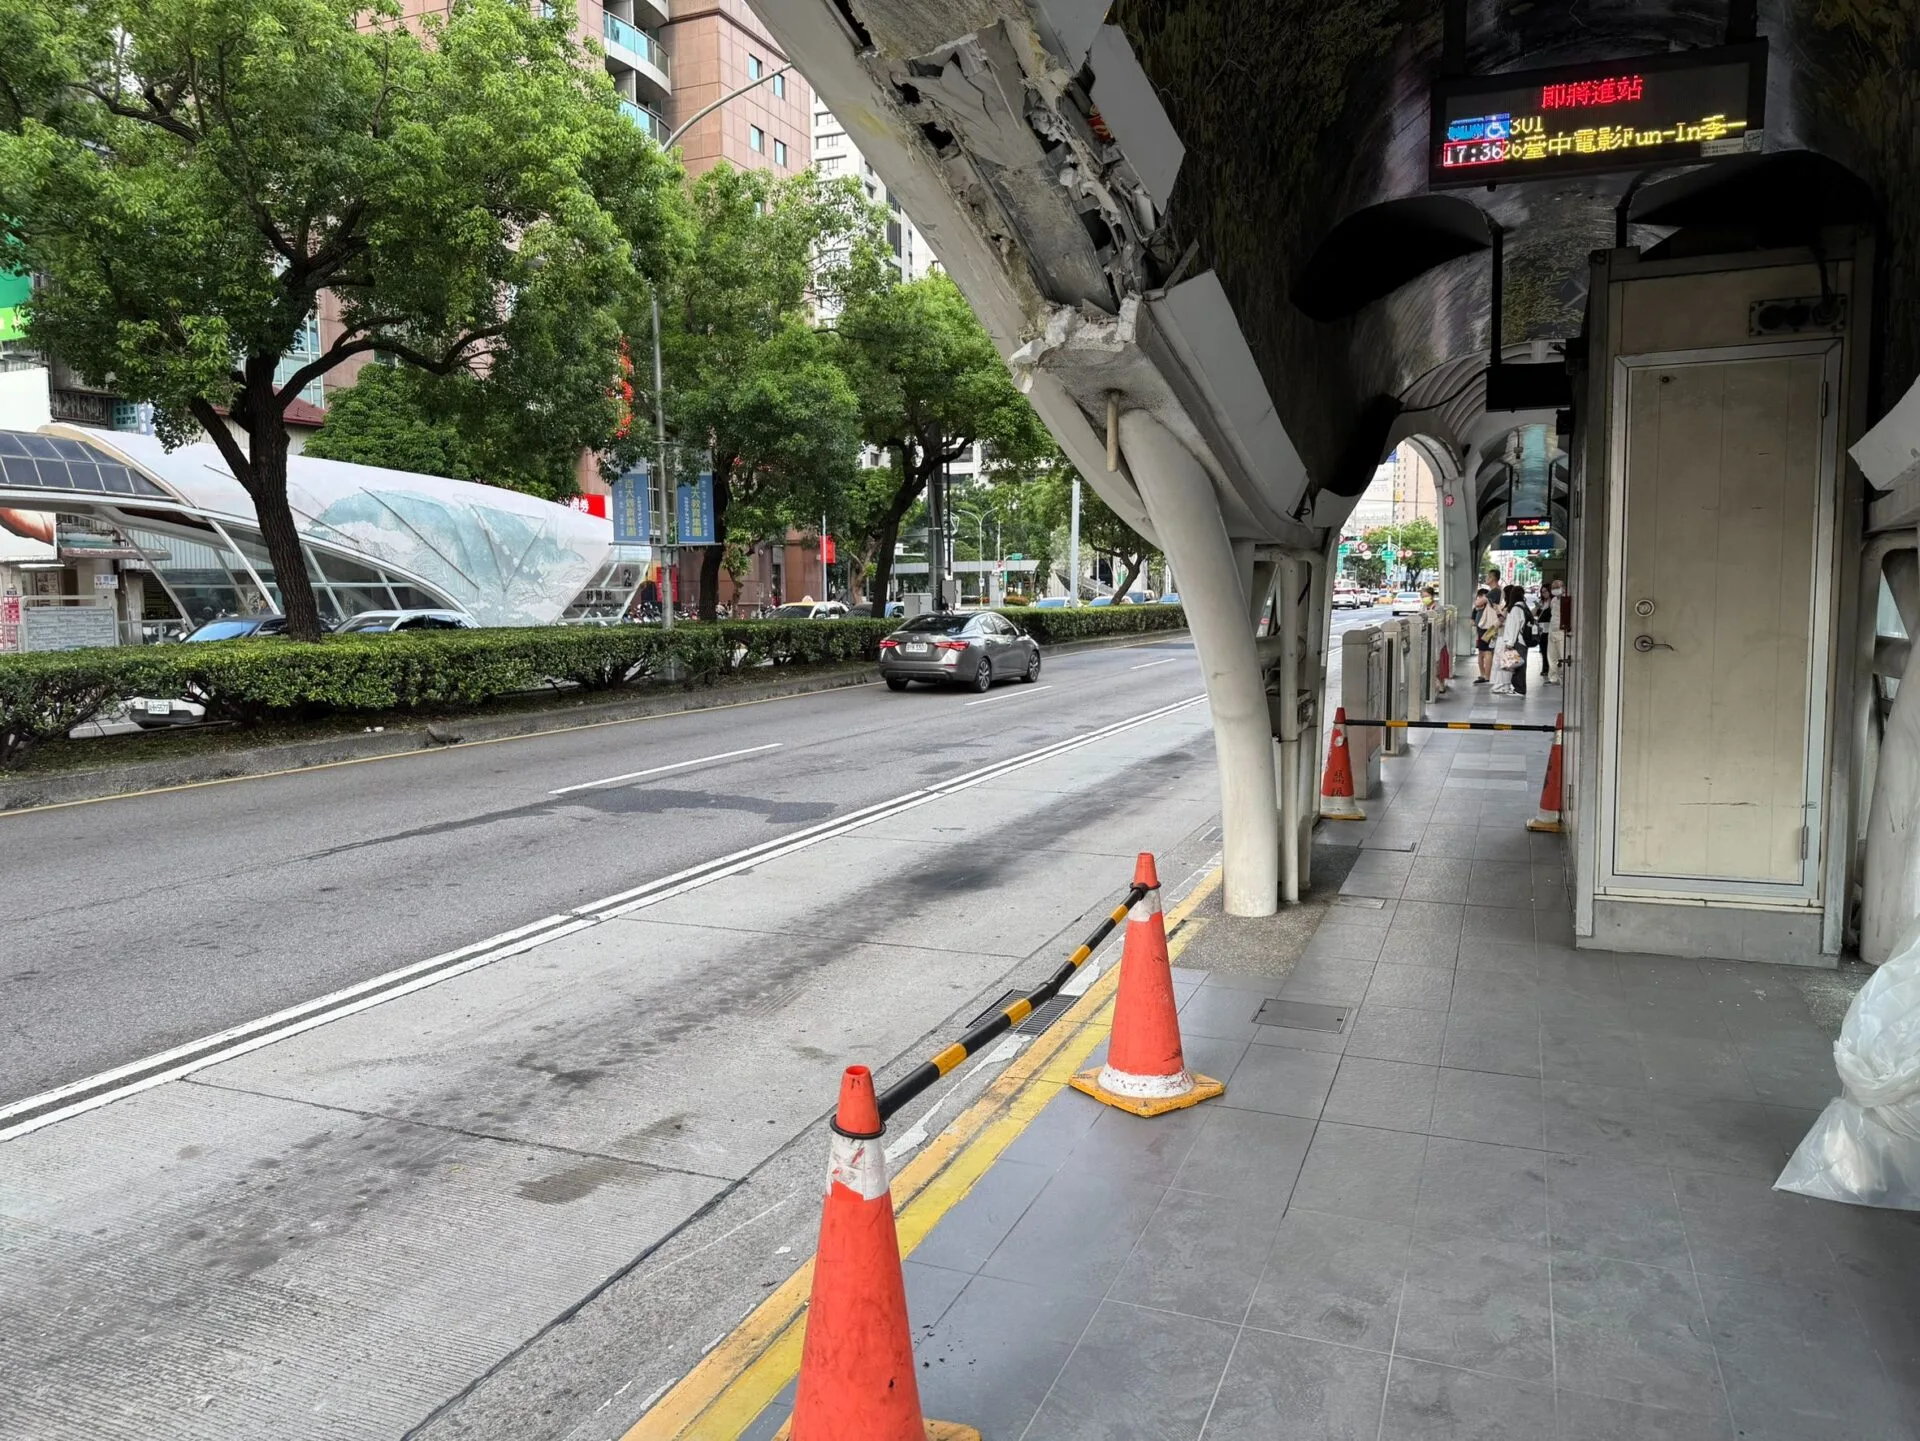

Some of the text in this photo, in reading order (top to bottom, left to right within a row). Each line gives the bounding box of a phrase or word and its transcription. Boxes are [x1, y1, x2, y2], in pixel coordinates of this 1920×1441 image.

[1541, 75, 1643, 109] 即將進站
[1446, 142, 1503, 165] 17:36
